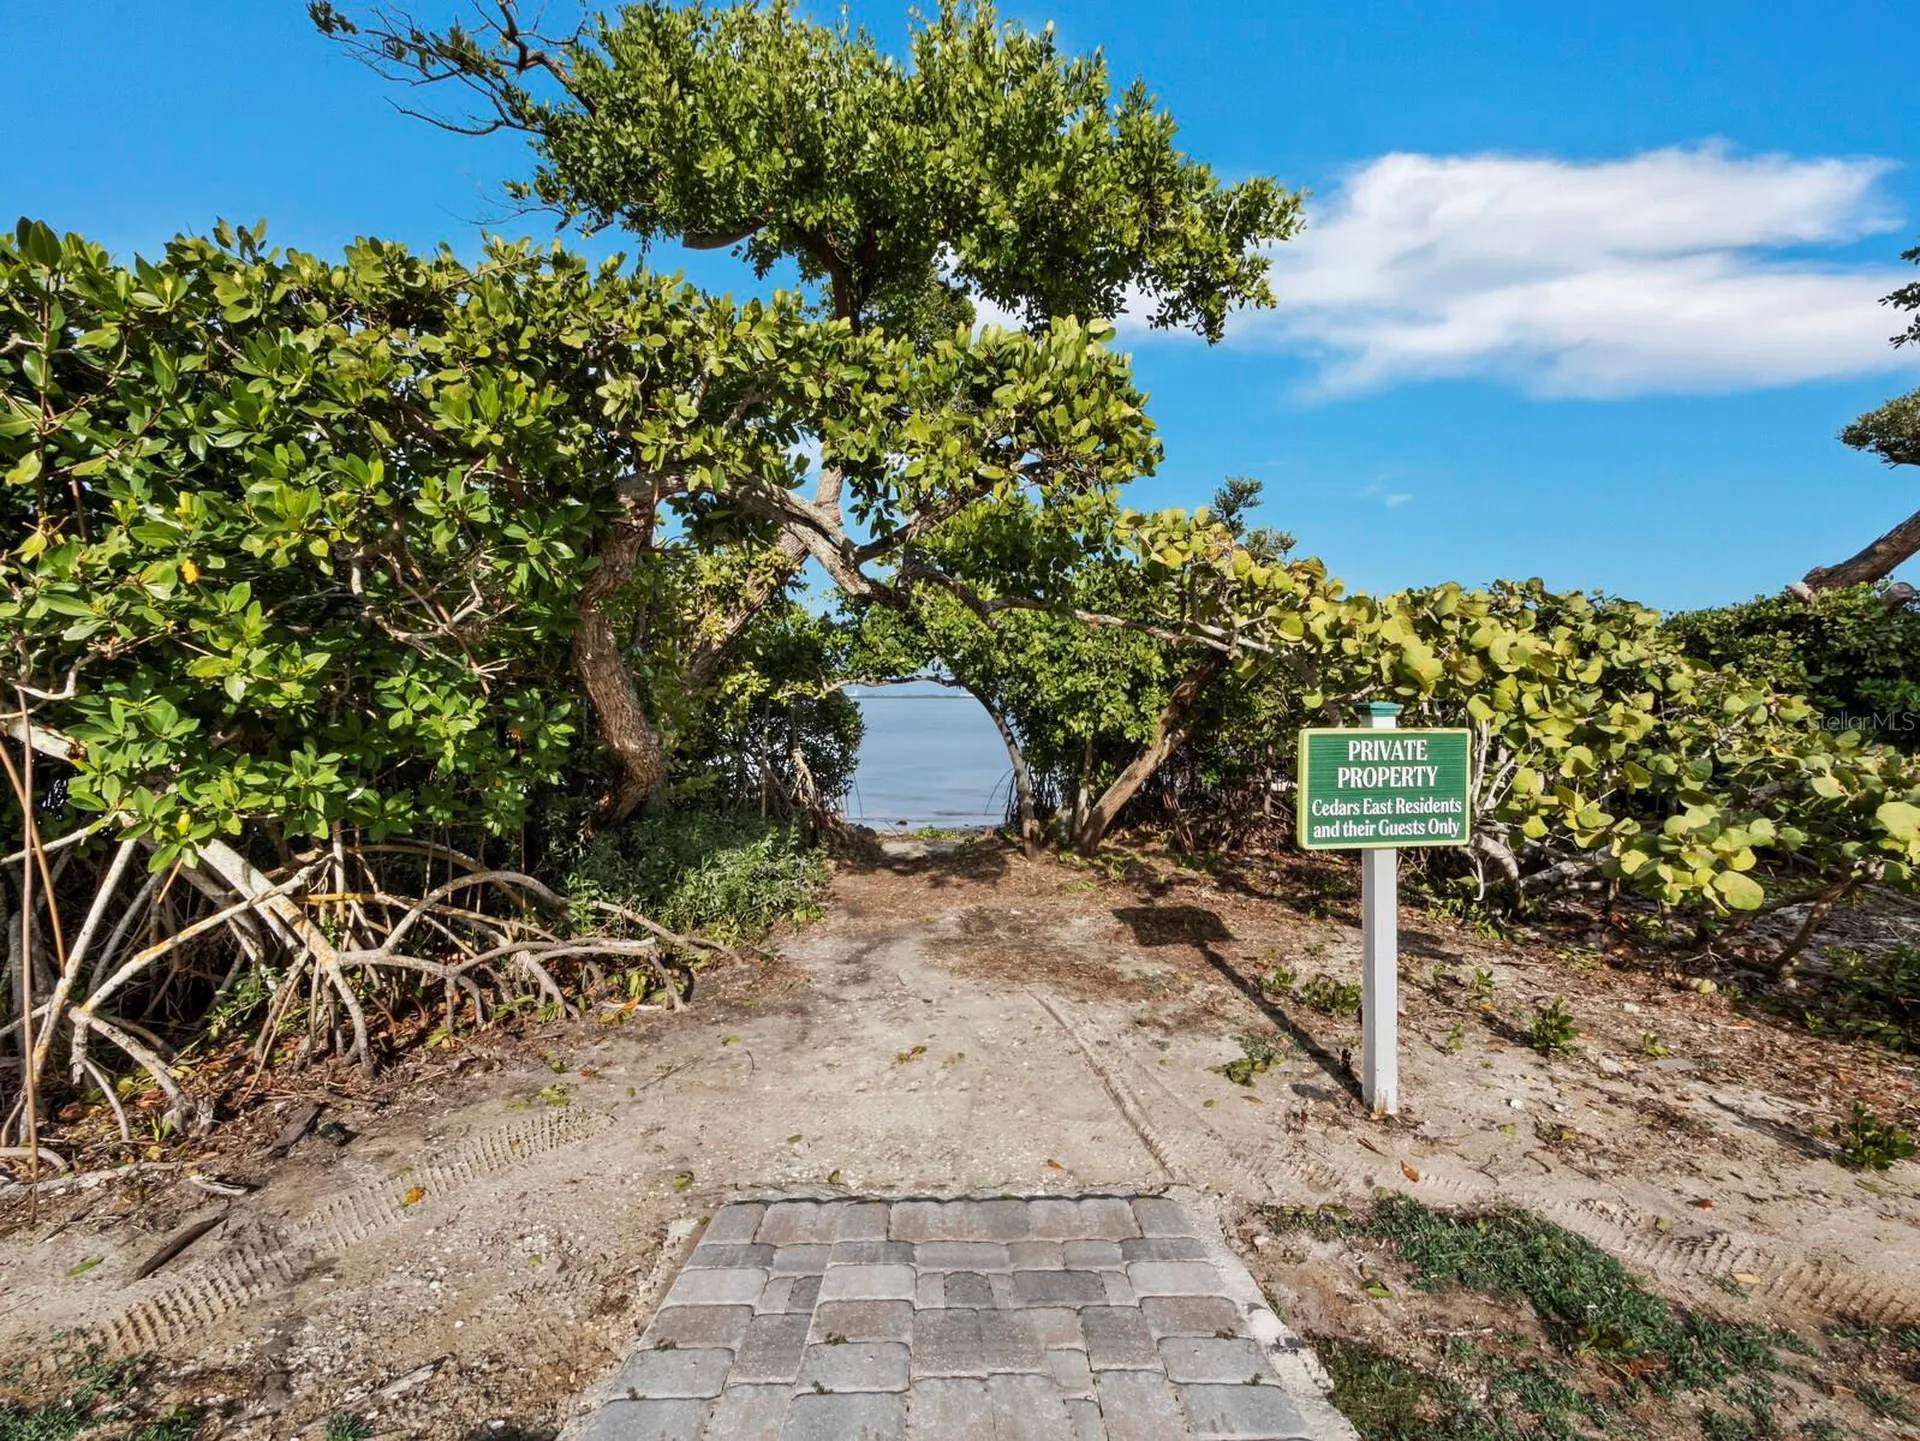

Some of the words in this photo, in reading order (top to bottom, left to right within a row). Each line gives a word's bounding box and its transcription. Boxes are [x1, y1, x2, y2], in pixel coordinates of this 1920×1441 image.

[1348, 739, 1428, 761] PRIVATE
[1337, 766, 1438, 788] PROPERTY
[1311, 799, 1360, 816] Cedars
[1363, 798, 1393, 815] East
[1395, 797, 1462, 814] Residents
[1313, 821, 1340, 838] and
[1342, 820, 1376, 837] their
[1378, 819, 1425, 836] Guests
[1428, 818, 1460, 838] Only
